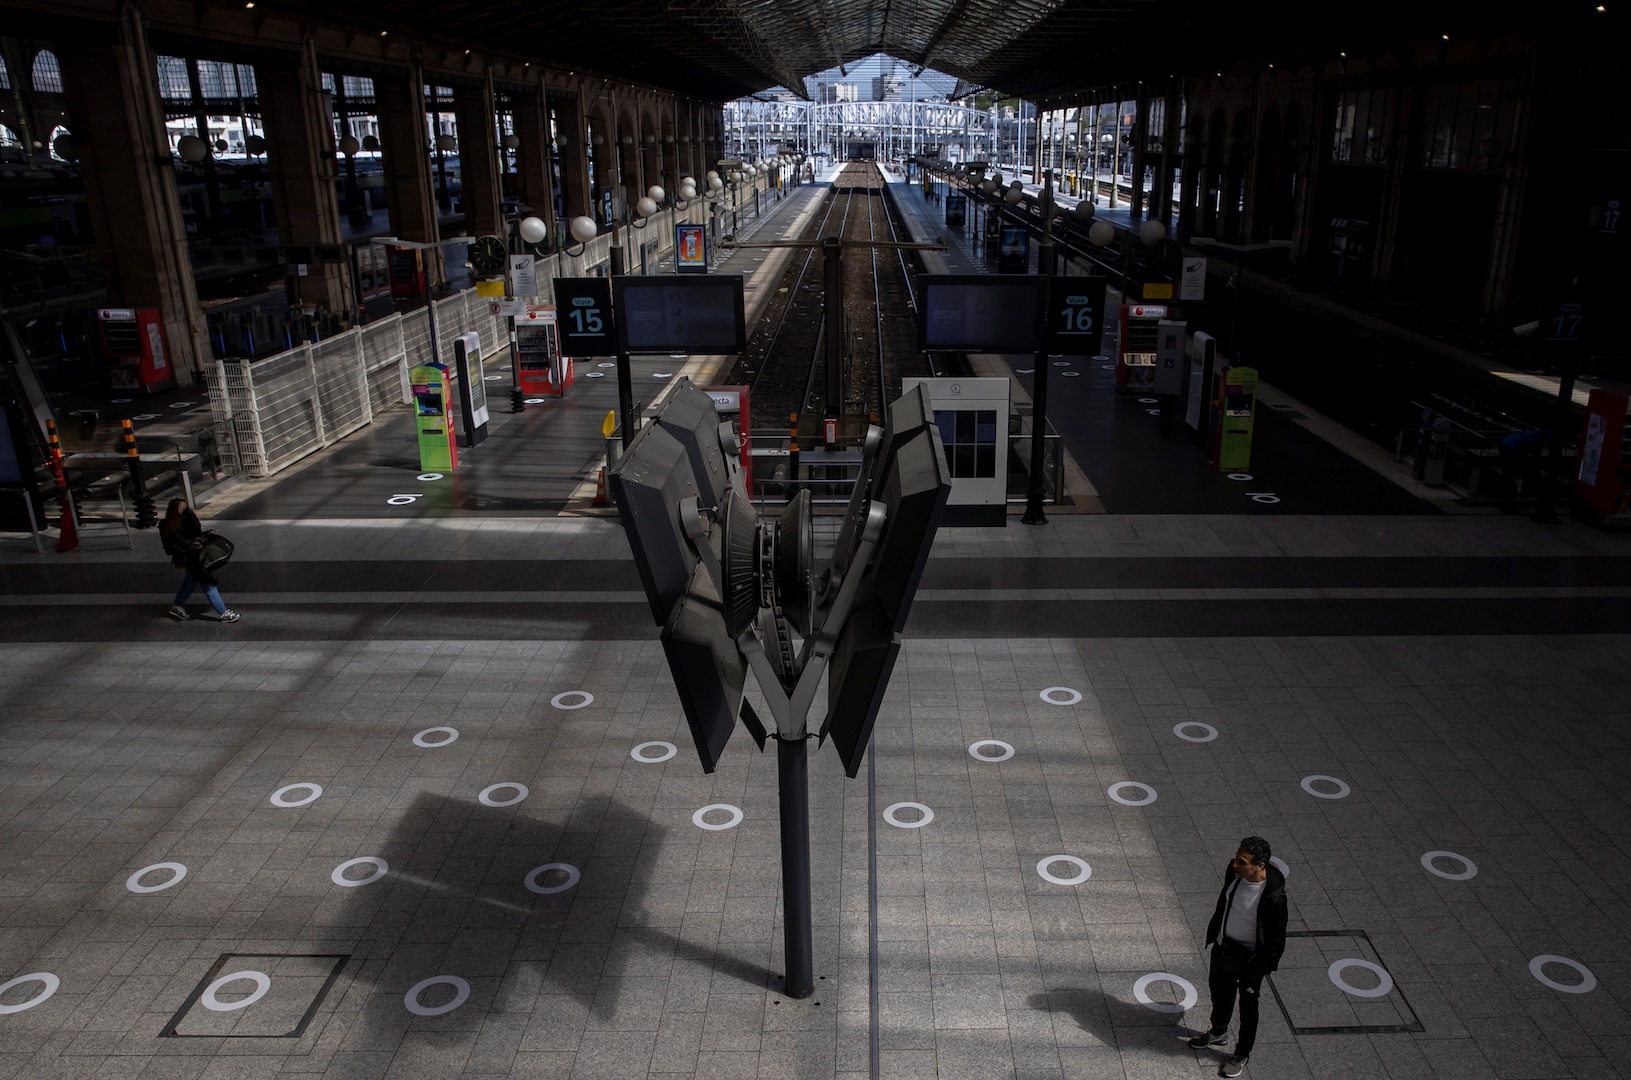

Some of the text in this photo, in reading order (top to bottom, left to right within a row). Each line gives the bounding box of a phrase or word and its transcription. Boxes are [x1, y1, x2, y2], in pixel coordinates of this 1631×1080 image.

[1604, 210, 1620, 229] 17
[569, 309, 603, 332] 15
[1061, 307, 1093, 331] 16
[1552, 314, 1584, 336] 17
